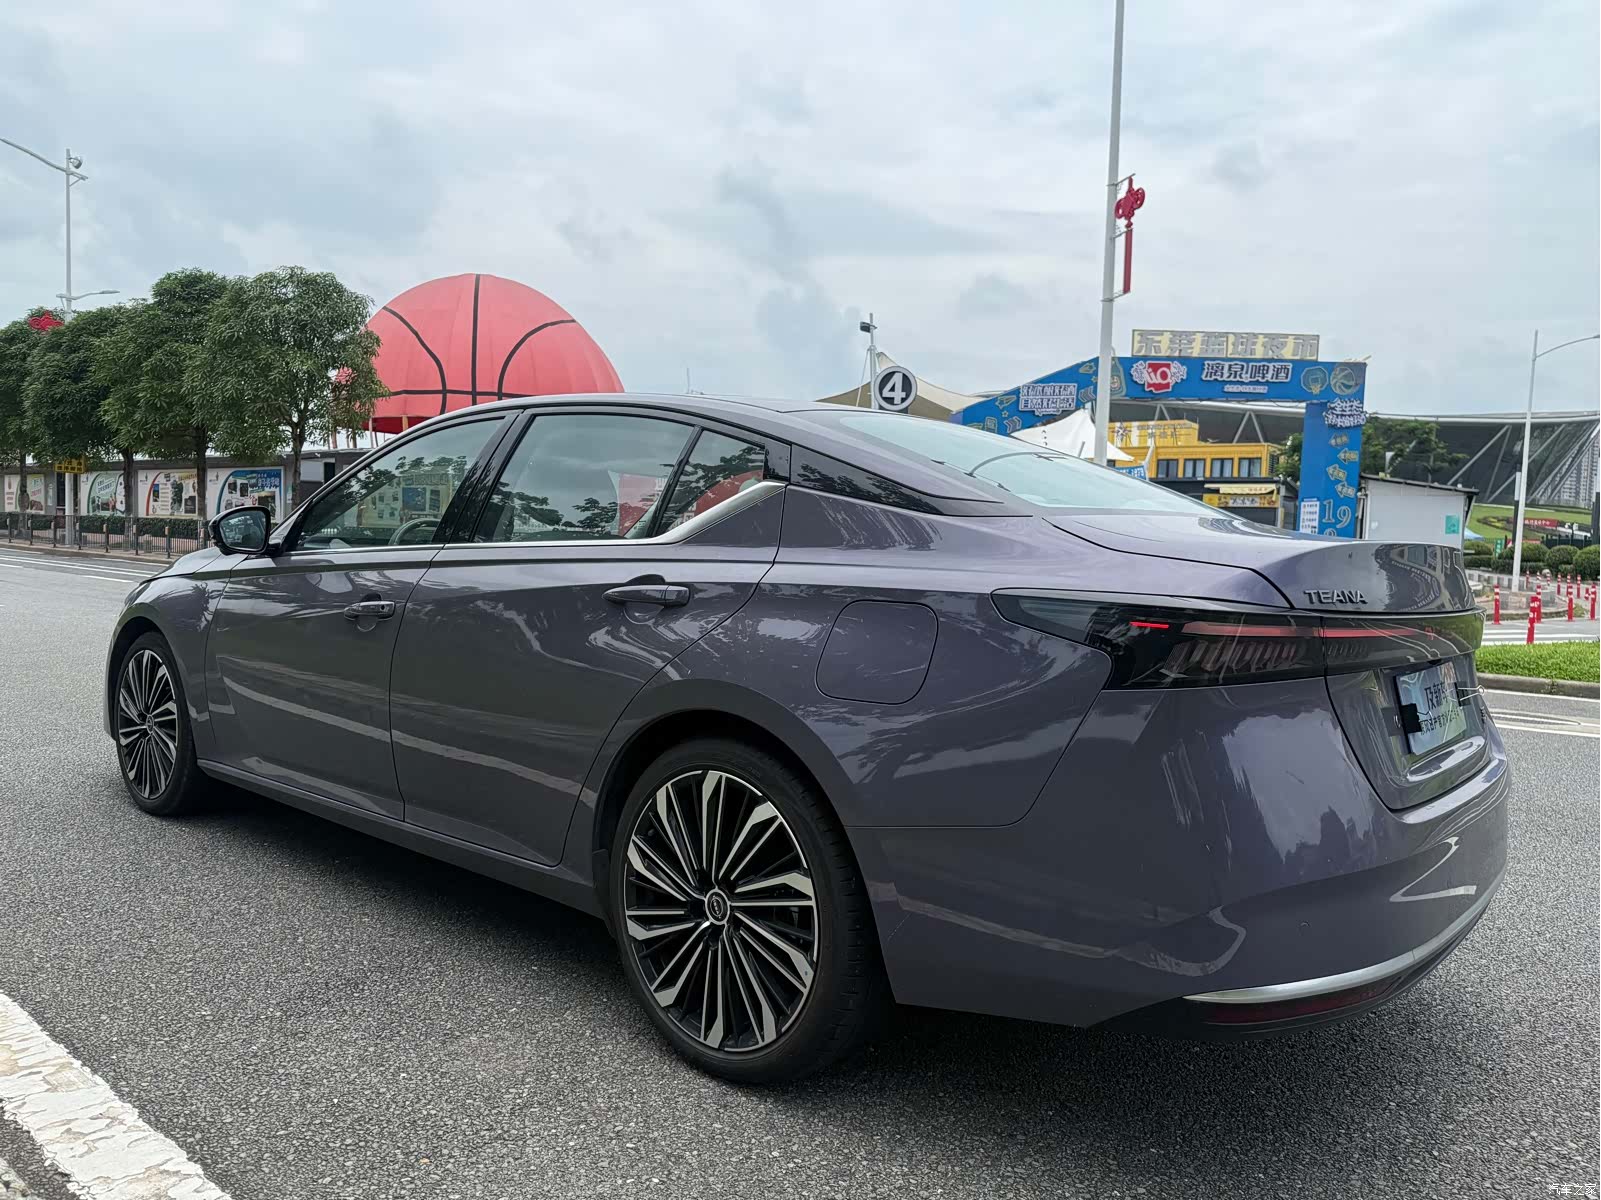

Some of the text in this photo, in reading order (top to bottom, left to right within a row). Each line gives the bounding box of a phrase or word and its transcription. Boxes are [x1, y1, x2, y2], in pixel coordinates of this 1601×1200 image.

[1134, 332, 1319, 360] 东莞篮球夜市
[1203, 361, 1291, 381] 漓泉啤酒
[882, 372, 906, 404] 4
[1304, 589, 1368, 604] TEANA
